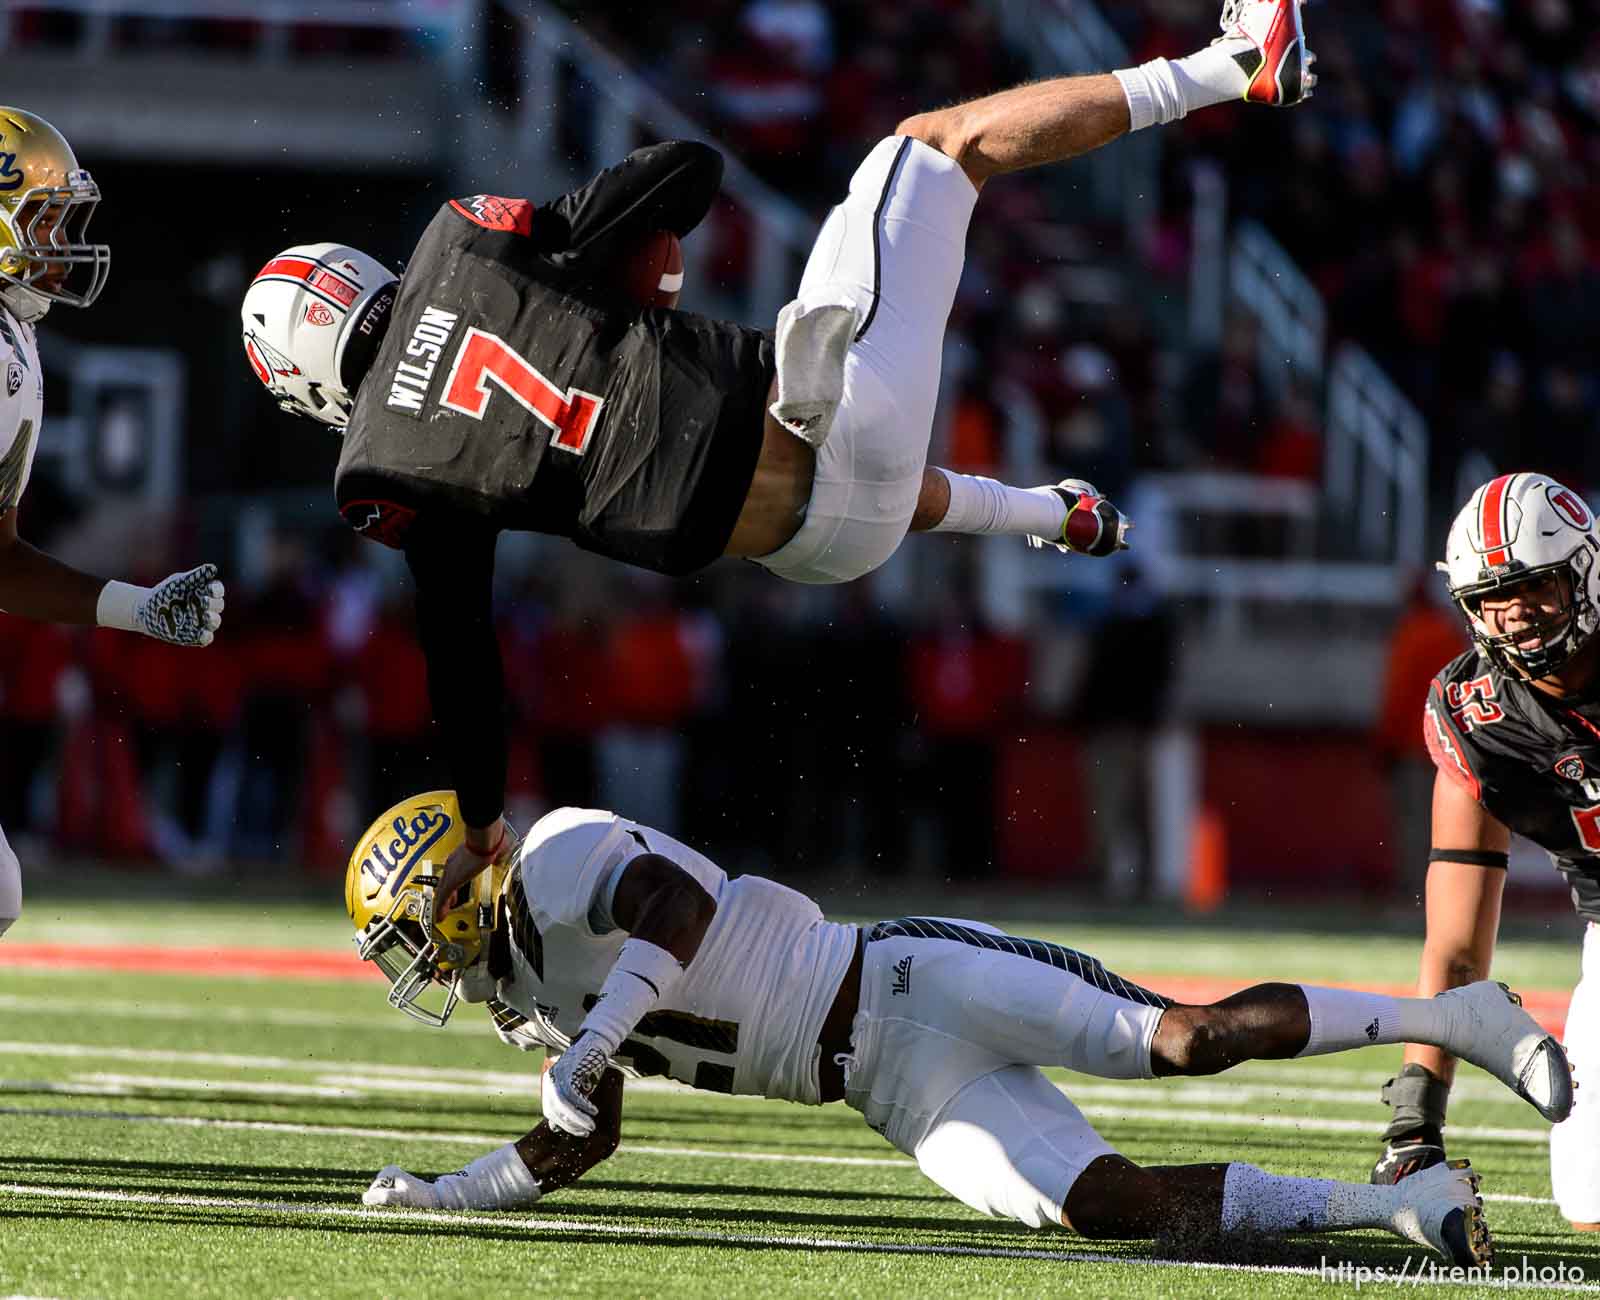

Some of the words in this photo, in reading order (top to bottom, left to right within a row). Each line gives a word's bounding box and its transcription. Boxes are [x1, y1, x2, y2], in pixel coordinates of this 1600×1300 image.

[360, 294, 393, 335] UTES
[386, 306, 458, 412] WILSON
[439, 326, 604, 456] 7
[1552, 490, 1589, 526] U
[1446, 673, 1506, 734] 52
